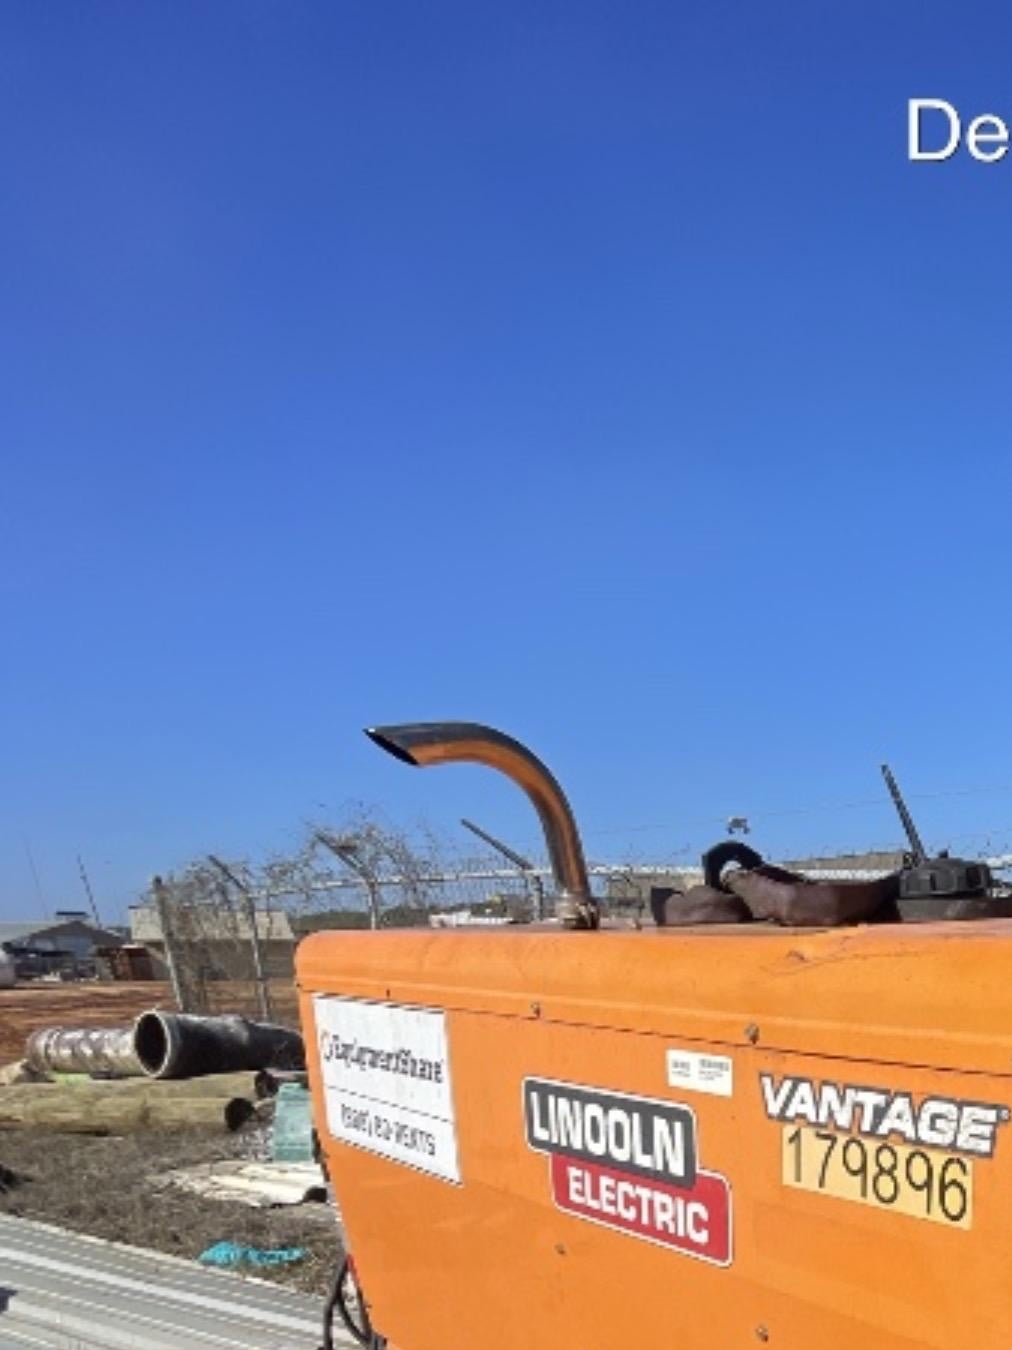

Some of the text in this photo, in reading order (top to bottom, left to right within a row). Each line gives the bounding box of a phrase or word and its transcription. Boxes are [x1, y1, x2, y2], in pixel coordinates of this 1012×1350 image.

[759, 1073, 999, 1156] VANTAGE
[567, 1165, 710, 1245] ELECTRIC
[788, 1127, 968, 1221] 179896
